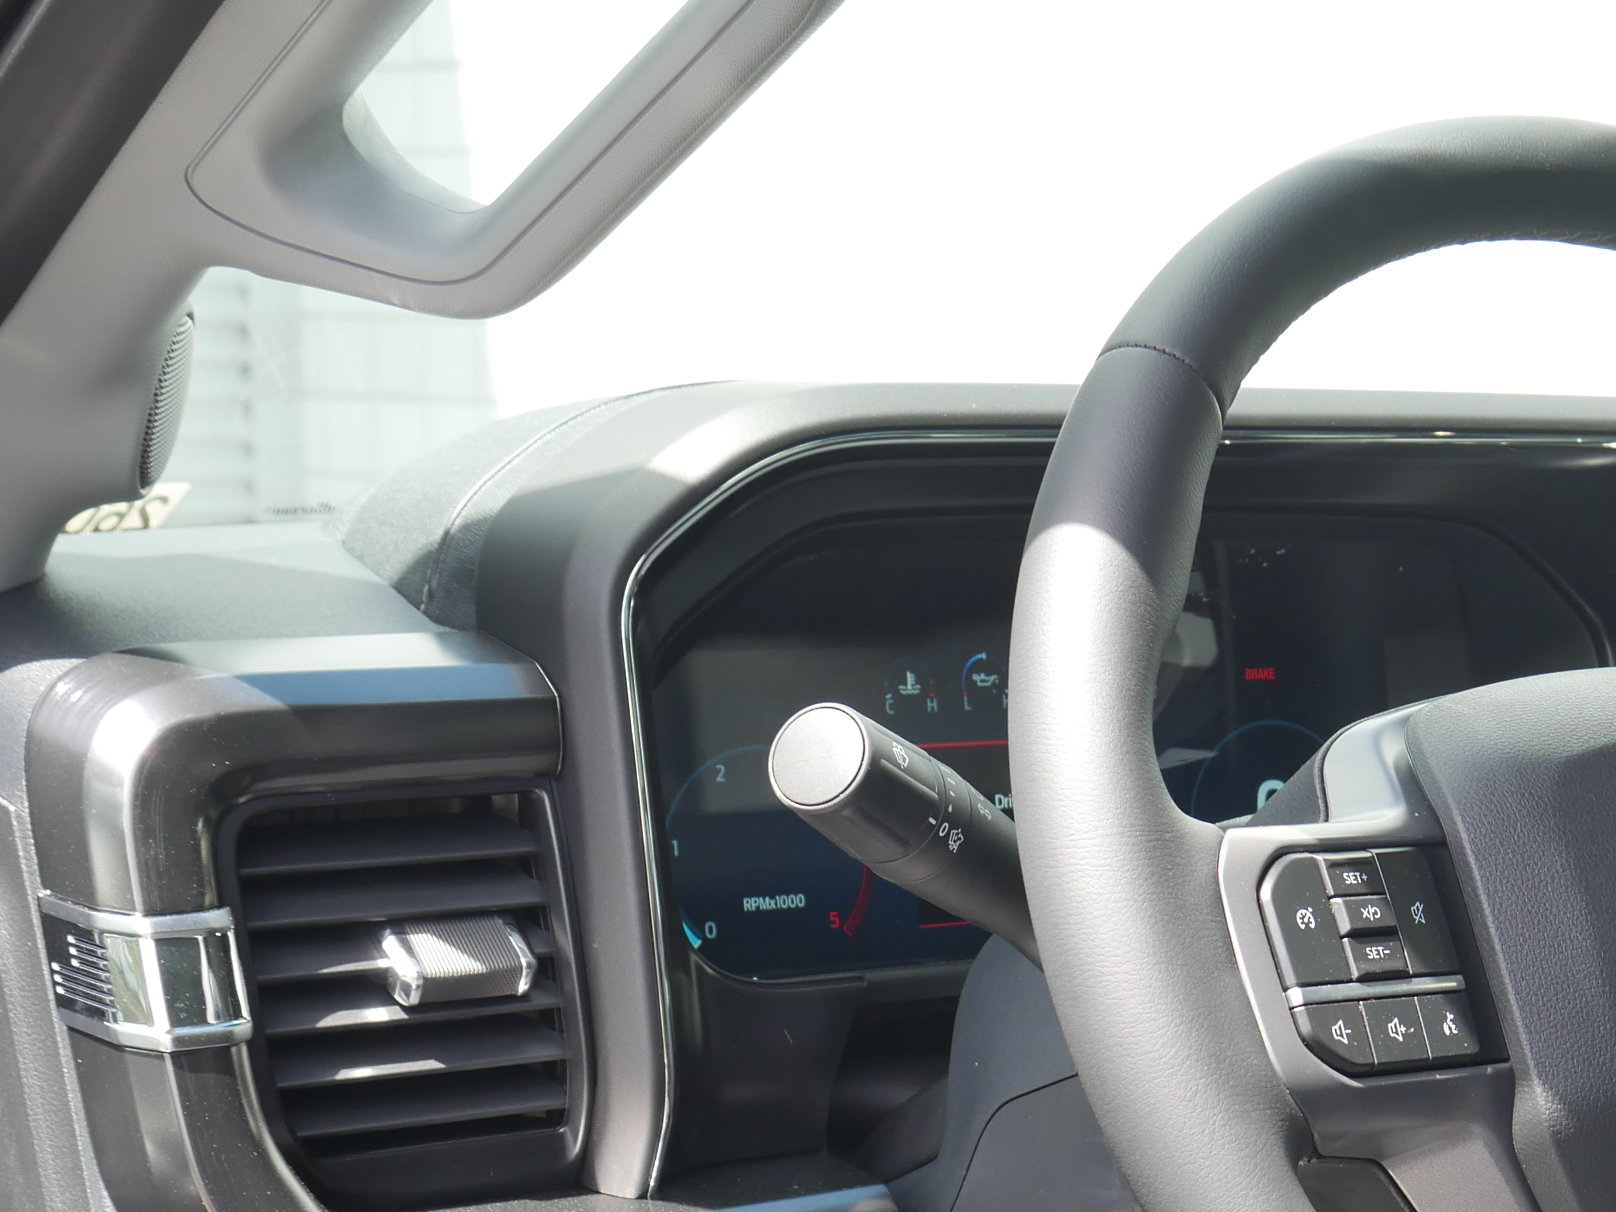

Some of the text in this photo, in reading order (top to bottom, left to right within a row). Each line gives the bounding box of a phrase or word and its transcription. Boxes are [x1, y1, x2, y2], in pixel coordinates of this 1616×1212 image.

[1244, 667, 1276, 681] BRAKE
[926, 698, 938, 712] H
[964, 696, 972, 710] L
[715, 764, 726, 782] 2
[994, 793, 1013, 808] Dri
[672, 840, 679, 857] 1
[743, 893, 806, 912] RPMx1000
[829, 911, 840, 928] 5
[705, 921, 717, 938] 0
